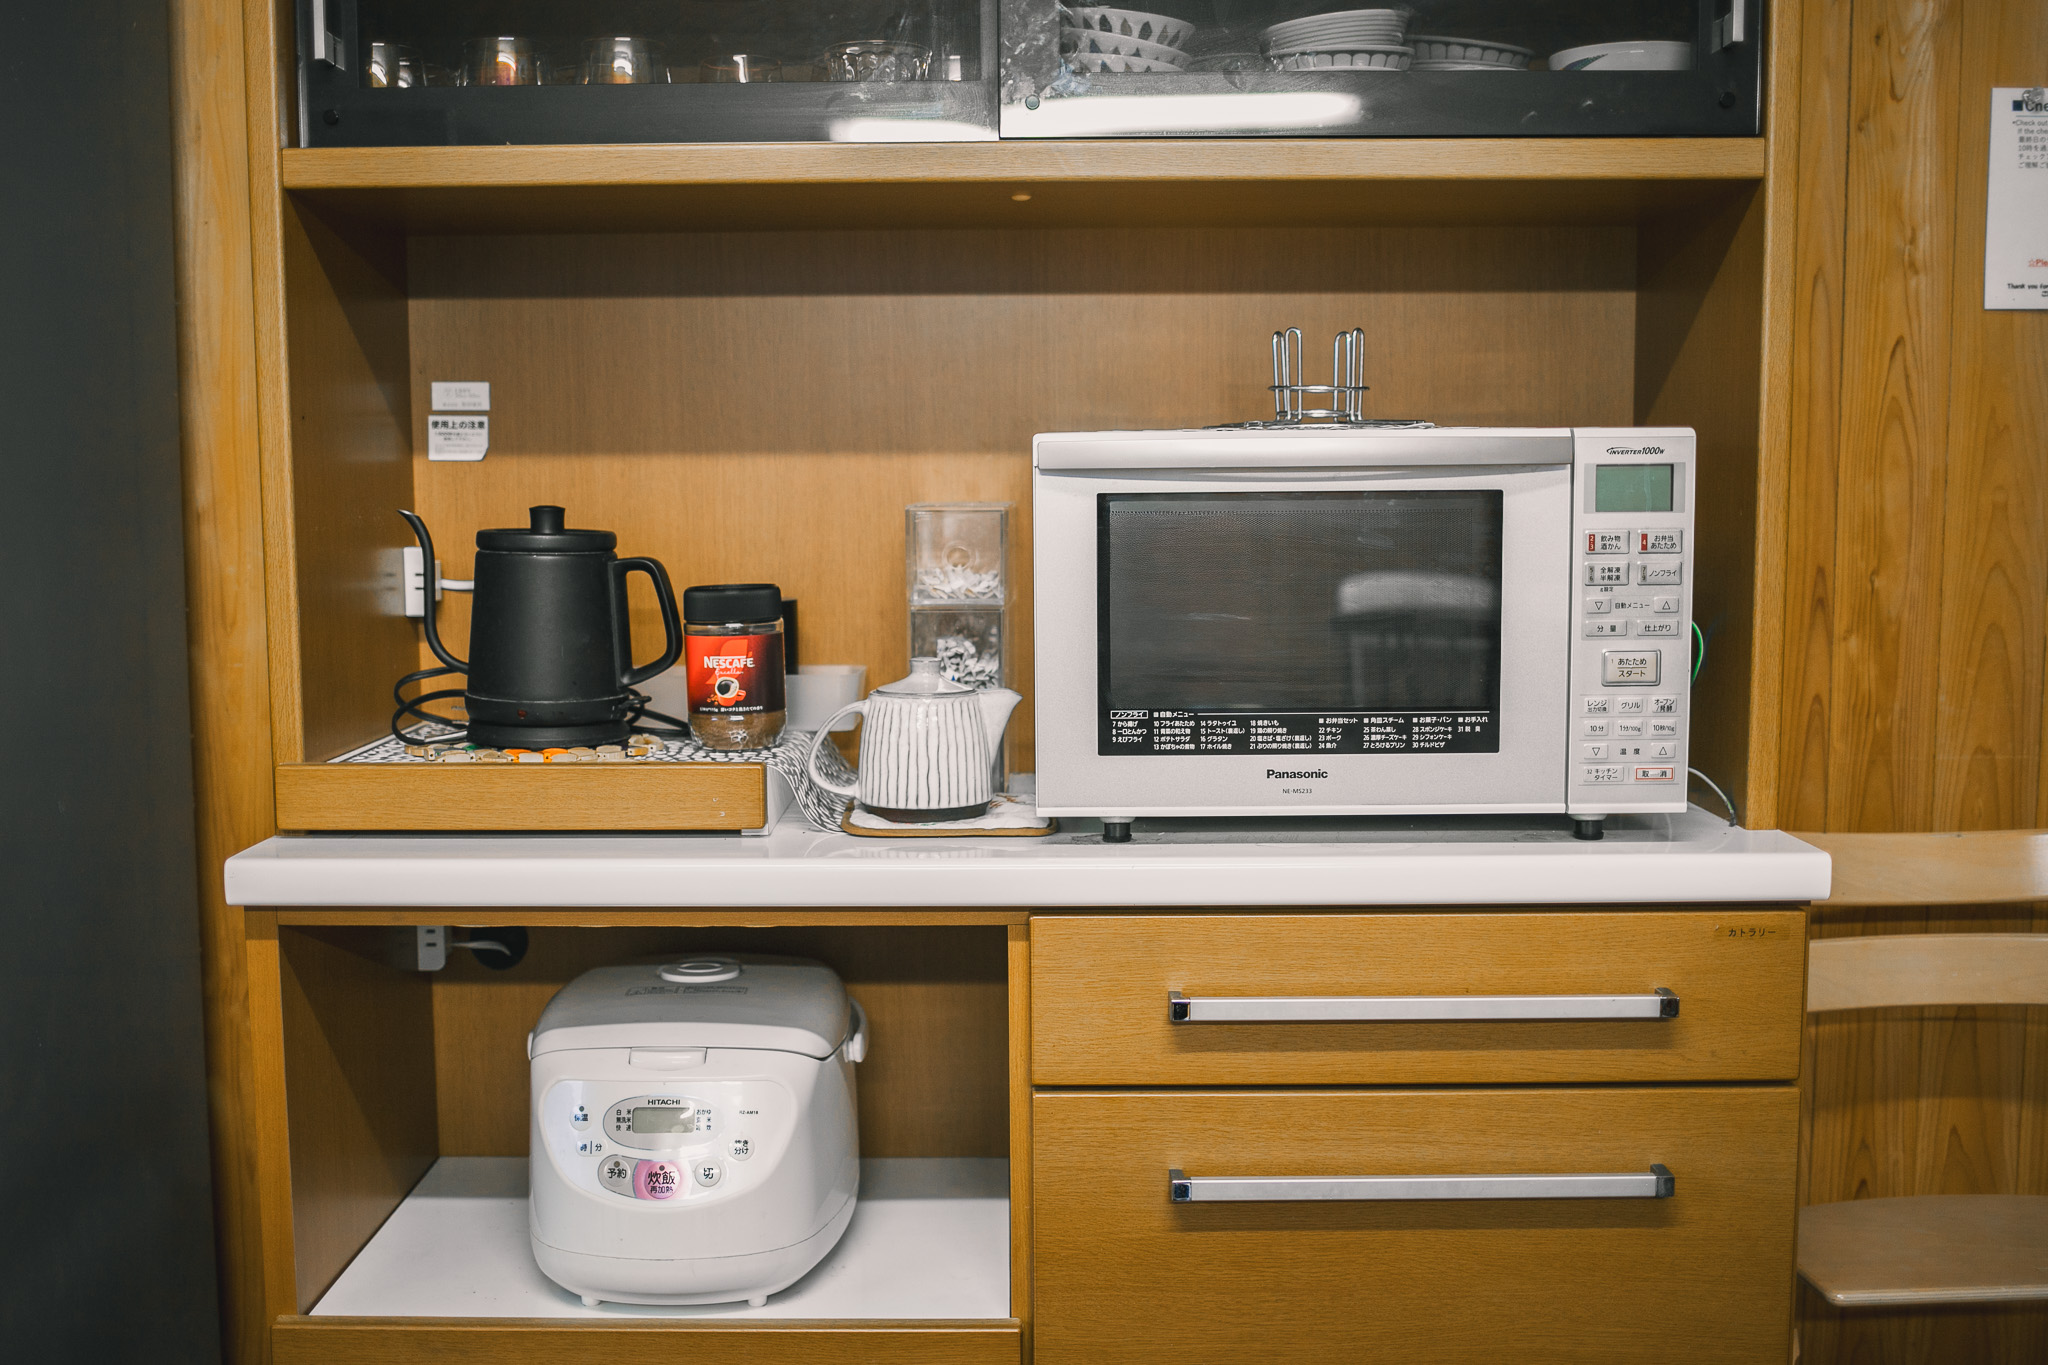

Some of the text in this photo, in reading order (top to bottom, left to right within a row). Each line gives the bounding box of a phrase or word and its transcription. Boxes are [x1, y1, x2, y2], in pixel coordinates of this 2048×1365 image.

[1650, 542, 1677, 550] あたため
[1614, 602, 1650, 610] 自動メニュー
[1644, 624, 1672, 632] 仕上がり
[1618, 658, 1647, 666] あたため
[1618, 670, 1646, 678] スタート
[1266, 768, 1328, 778] Panasonic
[1728, 928, 1776, 937] カトラリー
[606, 1168, 626, 1179] 予約
[648, 1170, 676, 1186] 炊飯
